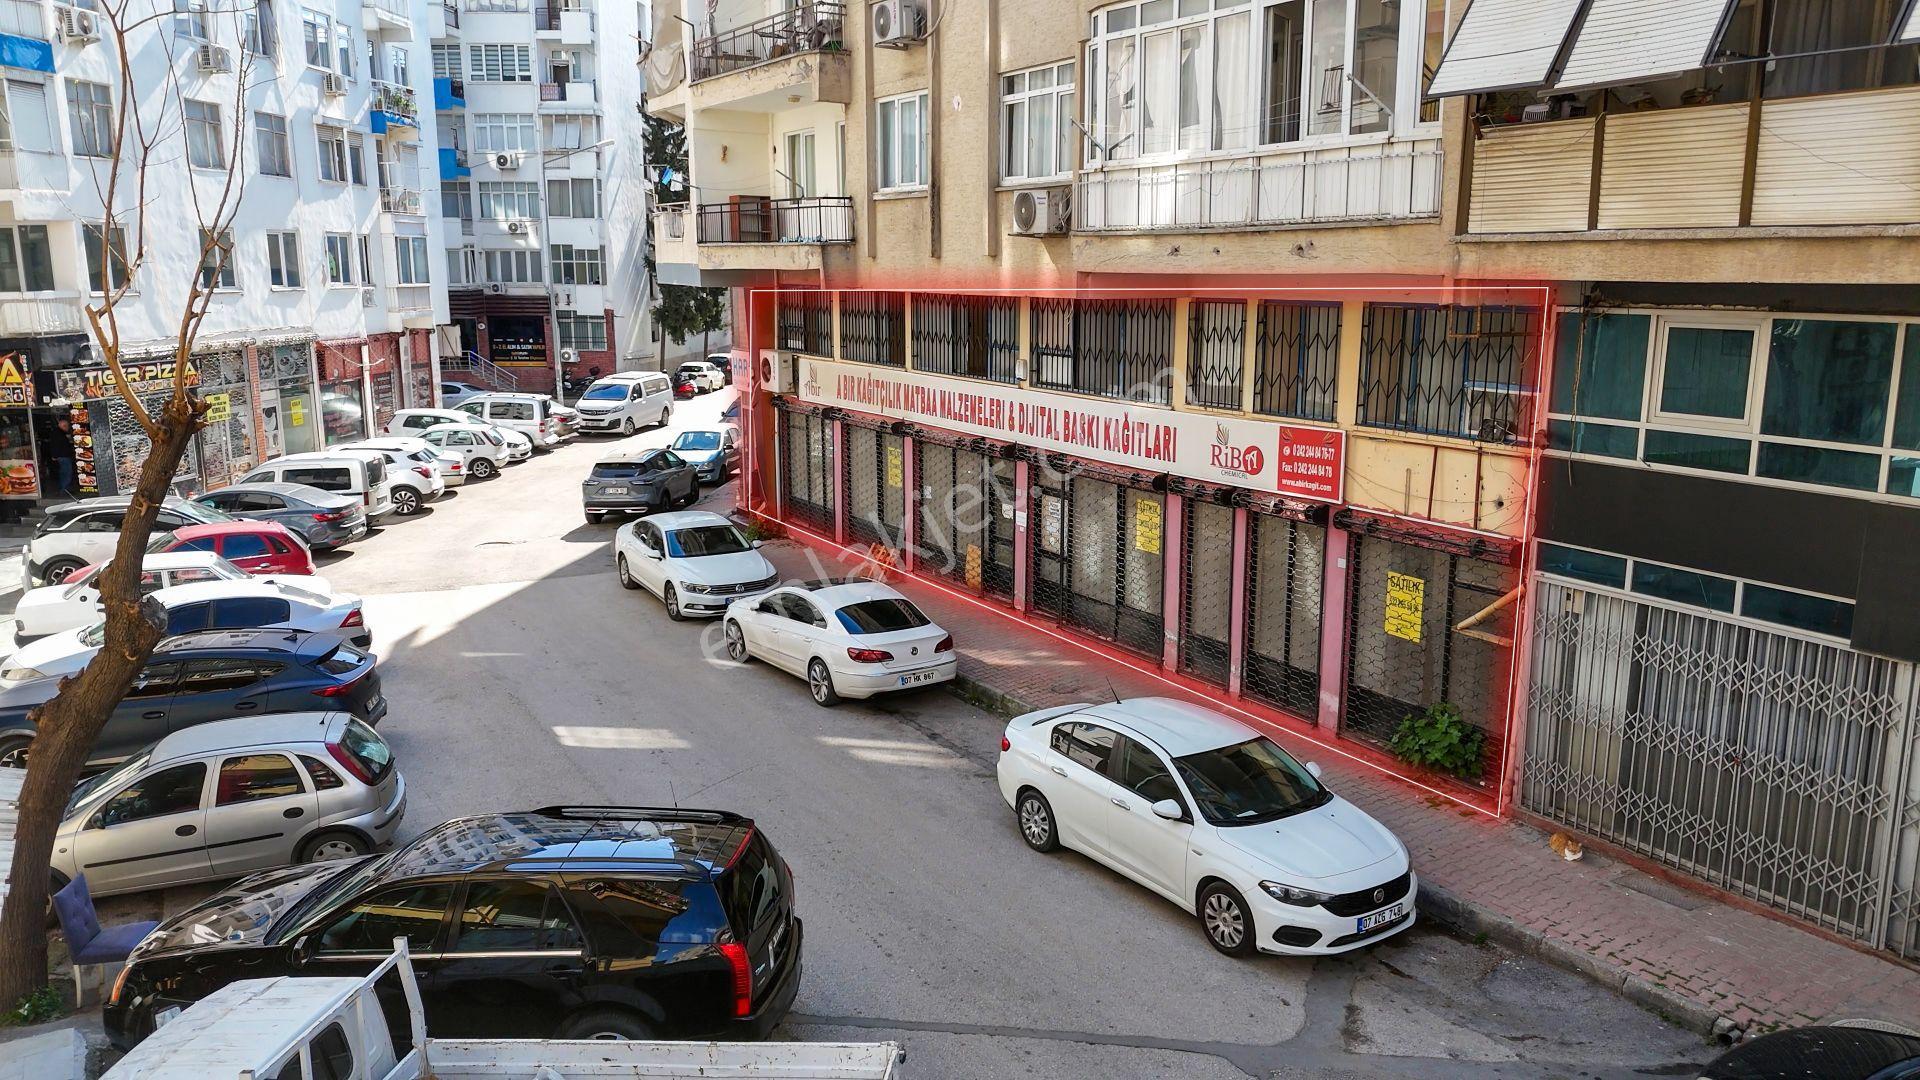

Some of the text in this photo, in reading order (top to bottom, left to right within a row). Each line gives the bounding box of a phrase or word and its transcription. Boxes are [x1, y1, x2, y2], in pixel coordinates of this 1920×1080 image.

[85, 367, 140, 387] TIGR
[857, 372, 901, 413] KAĞITÇILIK
[904, 383, 937, 417] MATBAA
[940, 389, 1005, 430] MALZEMELERI
[1008, 400, 1015, 432] &
[1018, 402, 1059, 441] DIJITAL
[1063, 410, 1099, 449] BASKI
[1103, 412, 1177, 463] KAĞITLARI
[1297, 445, 1305, 457] 242
[1298, 462, 1307, 474] 242
[1308, 464, 1317, 475] 244
[1318, 465, 1324, 477] 84
[1363, 917, 1371, 928] 07
